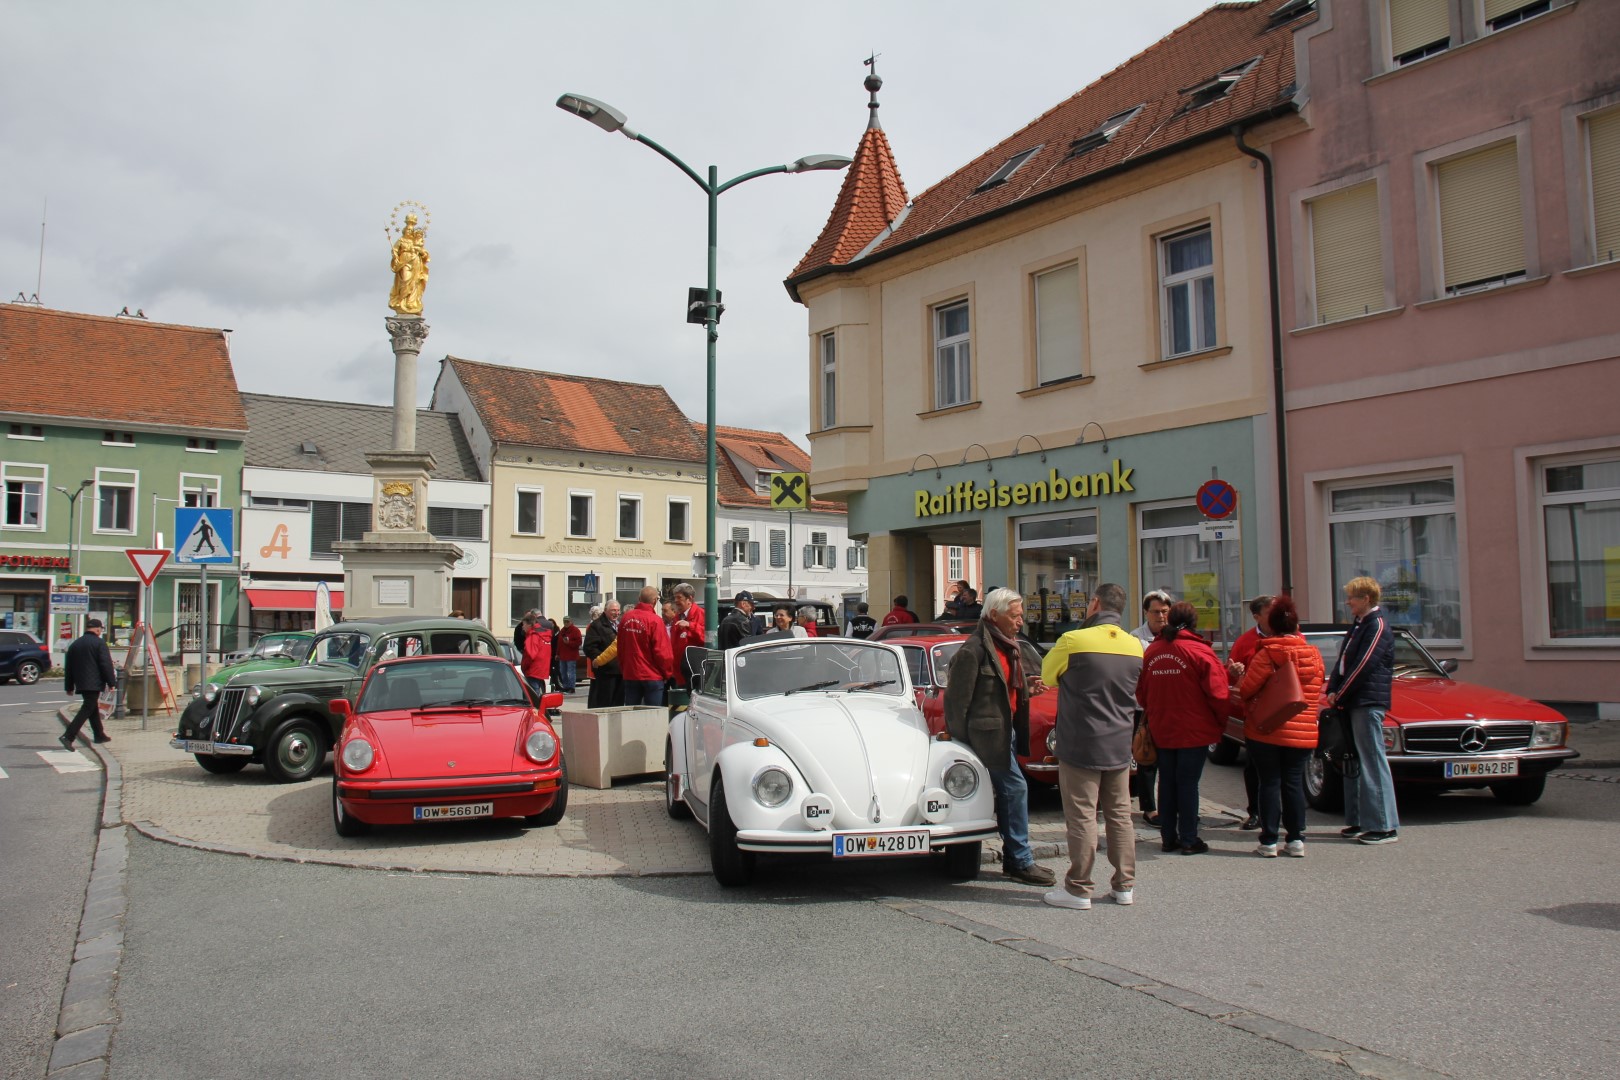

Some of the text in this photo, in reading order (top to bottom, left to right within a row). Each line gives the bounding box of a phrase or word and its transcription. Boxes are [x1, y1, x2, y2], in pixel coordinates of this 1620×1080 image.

[914, 458, 1135, 518] Raiffeisenbank
[546, 543, 652, 558] ANDREAS SCHINDLER
[1174, 656, 1187, 669] CLUB
[1453, 762, 1514, 775] OW 842 BF
[423, 805, 489, 817] OW 566 DM
[846, 835, 925, 852] OW 428 DY
